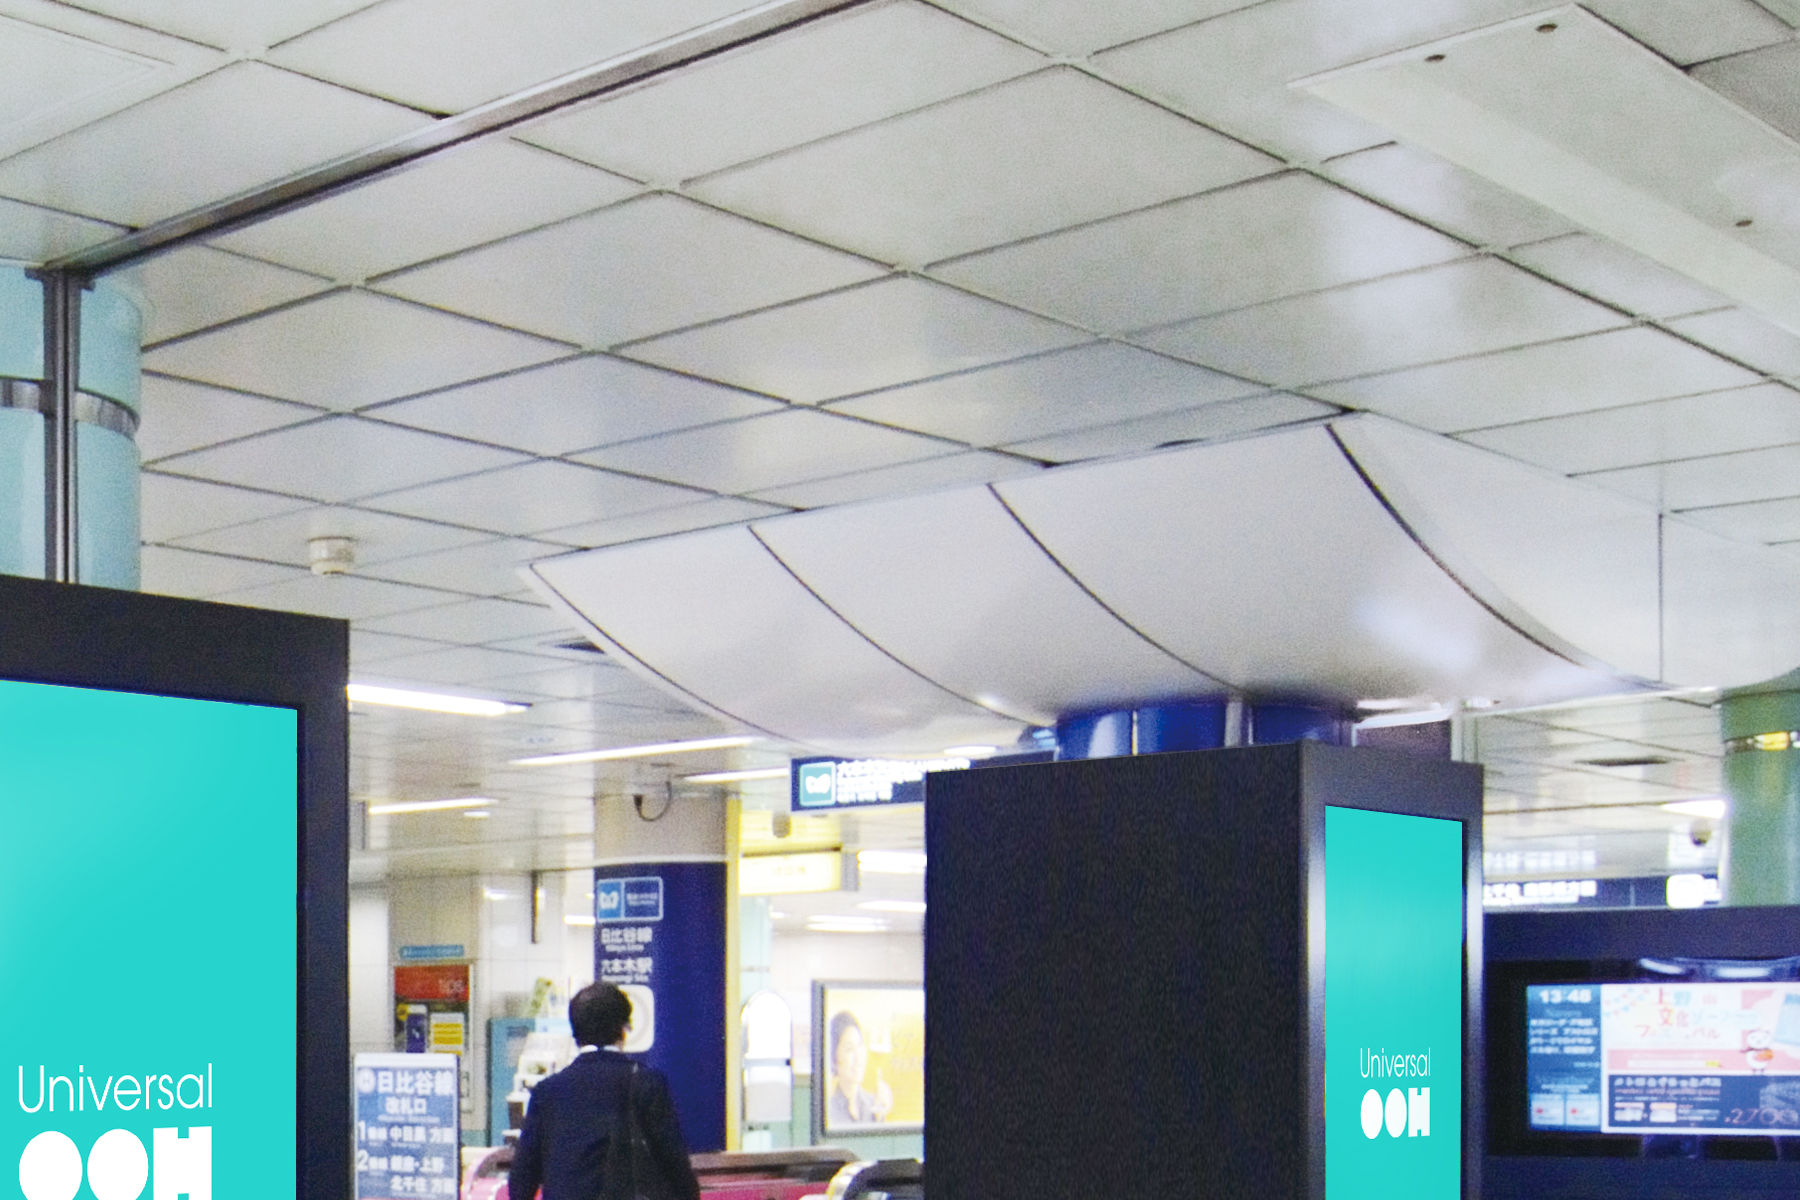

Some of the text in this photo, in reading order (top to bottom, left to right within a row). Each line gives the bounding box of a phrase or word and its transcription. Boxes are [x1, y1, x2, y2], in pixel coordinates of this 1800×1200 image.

[377, 1070, 454, 1095] 日比谷線
[1360, 1047, 1431, 1079] Universal
[19, 1063, 212, 1113] Universal
[1360, 1087, 1431, 1139] OOH
